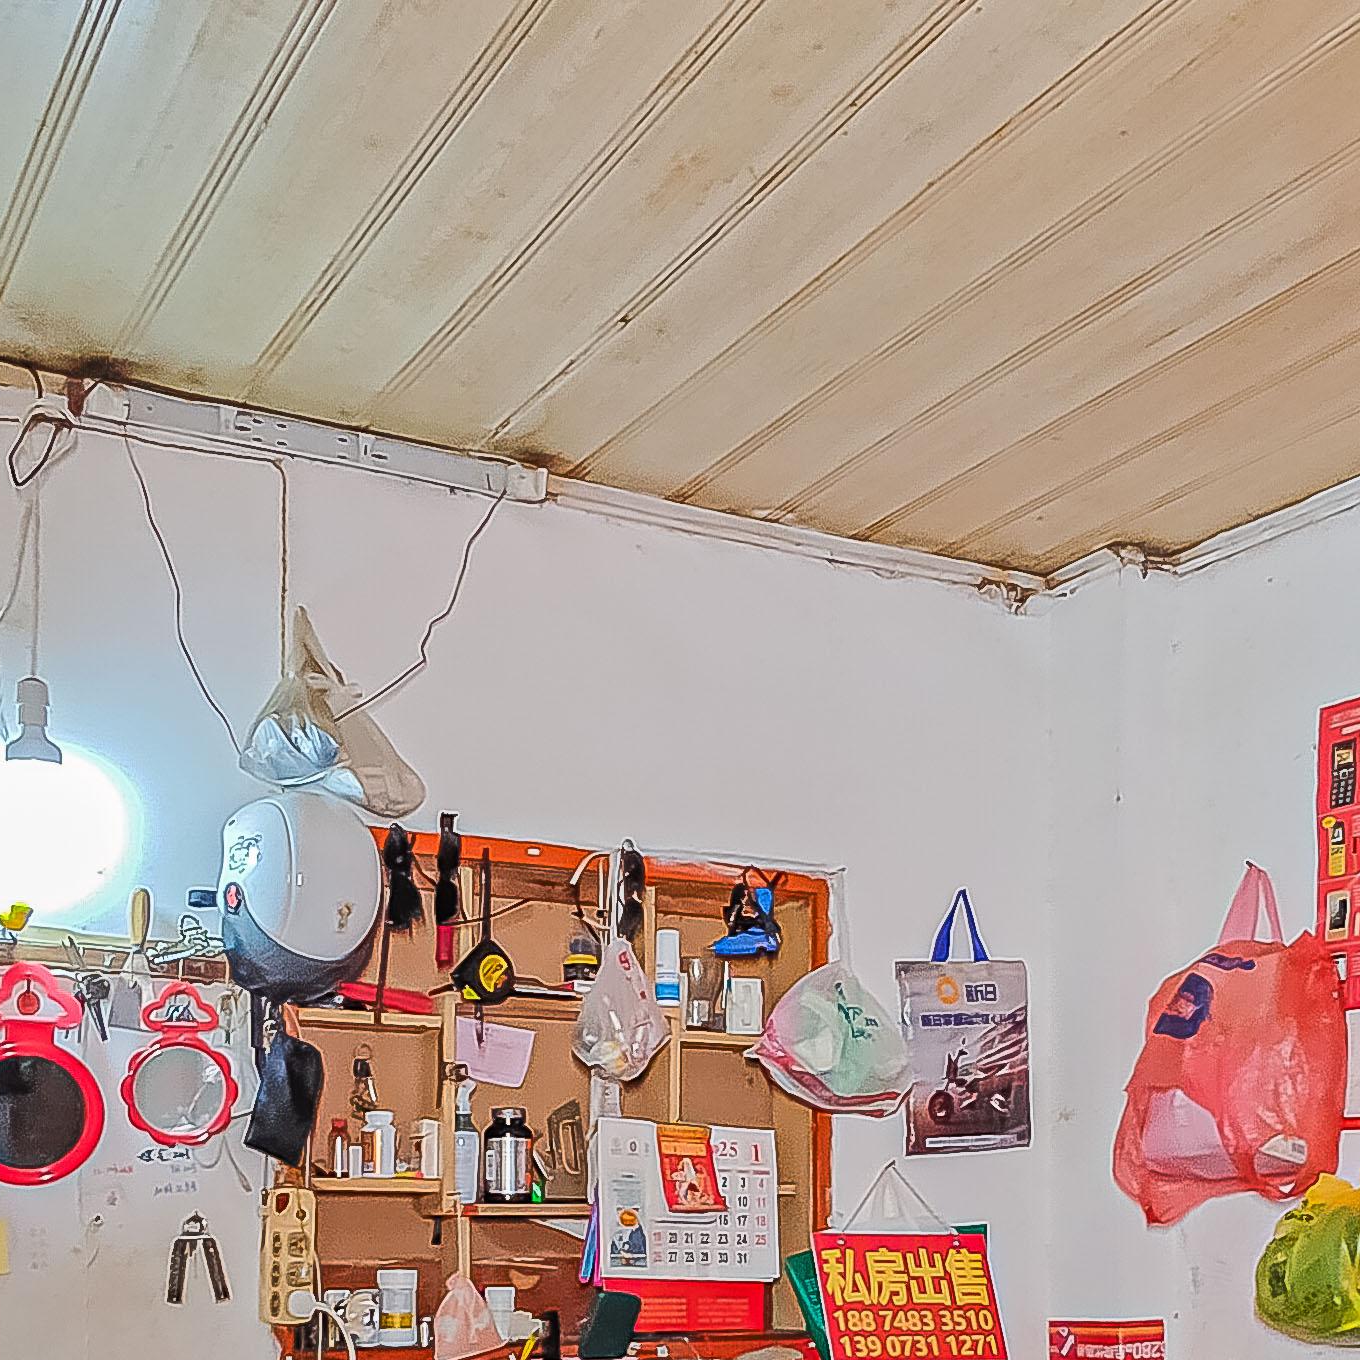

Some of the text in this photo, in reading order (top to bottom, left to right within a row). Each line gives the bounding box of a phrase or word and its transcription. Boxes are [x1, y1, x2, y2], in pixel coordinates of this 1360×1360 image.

[820, 1247, 990, 1306] 私房出售
[832, 1309, 994, 1332] 188 7483 3510
[840, 1334, 998, 1357] 139 0731 1271
